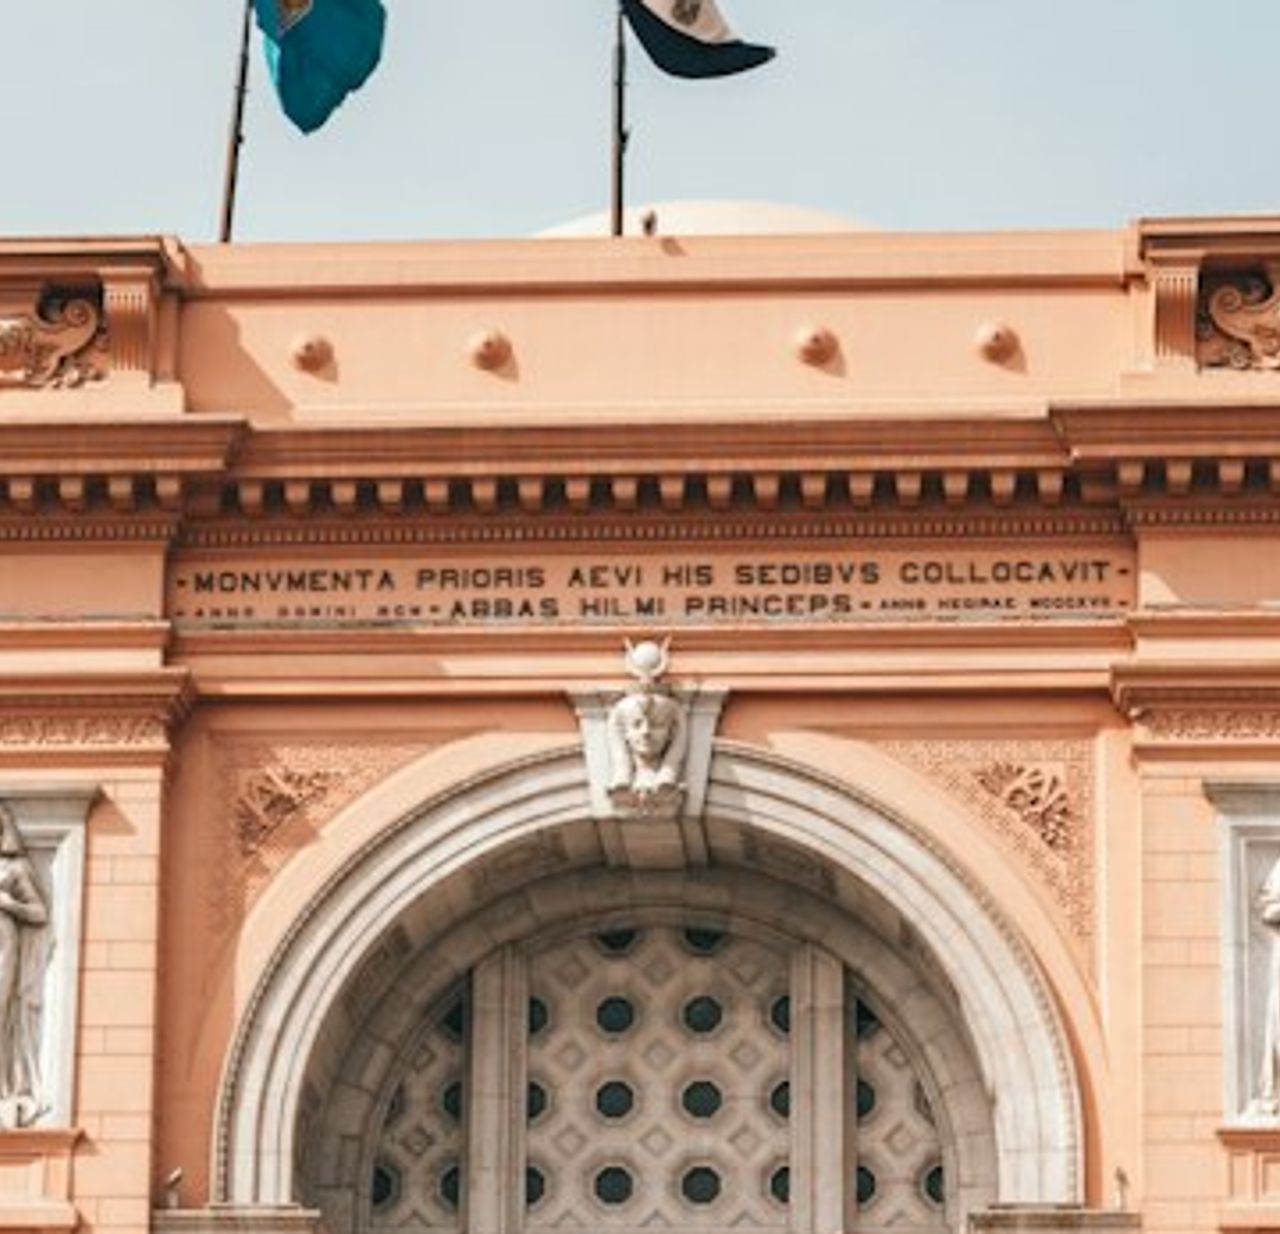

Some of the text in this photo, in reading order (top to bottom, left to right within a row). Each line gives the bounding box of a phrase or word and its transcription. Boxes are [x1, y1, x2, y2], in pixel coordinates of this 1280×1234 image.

[193, 560, 1111, 593] MONVMENTA PRIORIS AEVI HIS SEDIBVS COLLOCAVIT
[450, 598, 559, 619] ABBAS
[579, 597, 665, 617] HILMI
[685, 593, 853, 616] PRINCEPS
